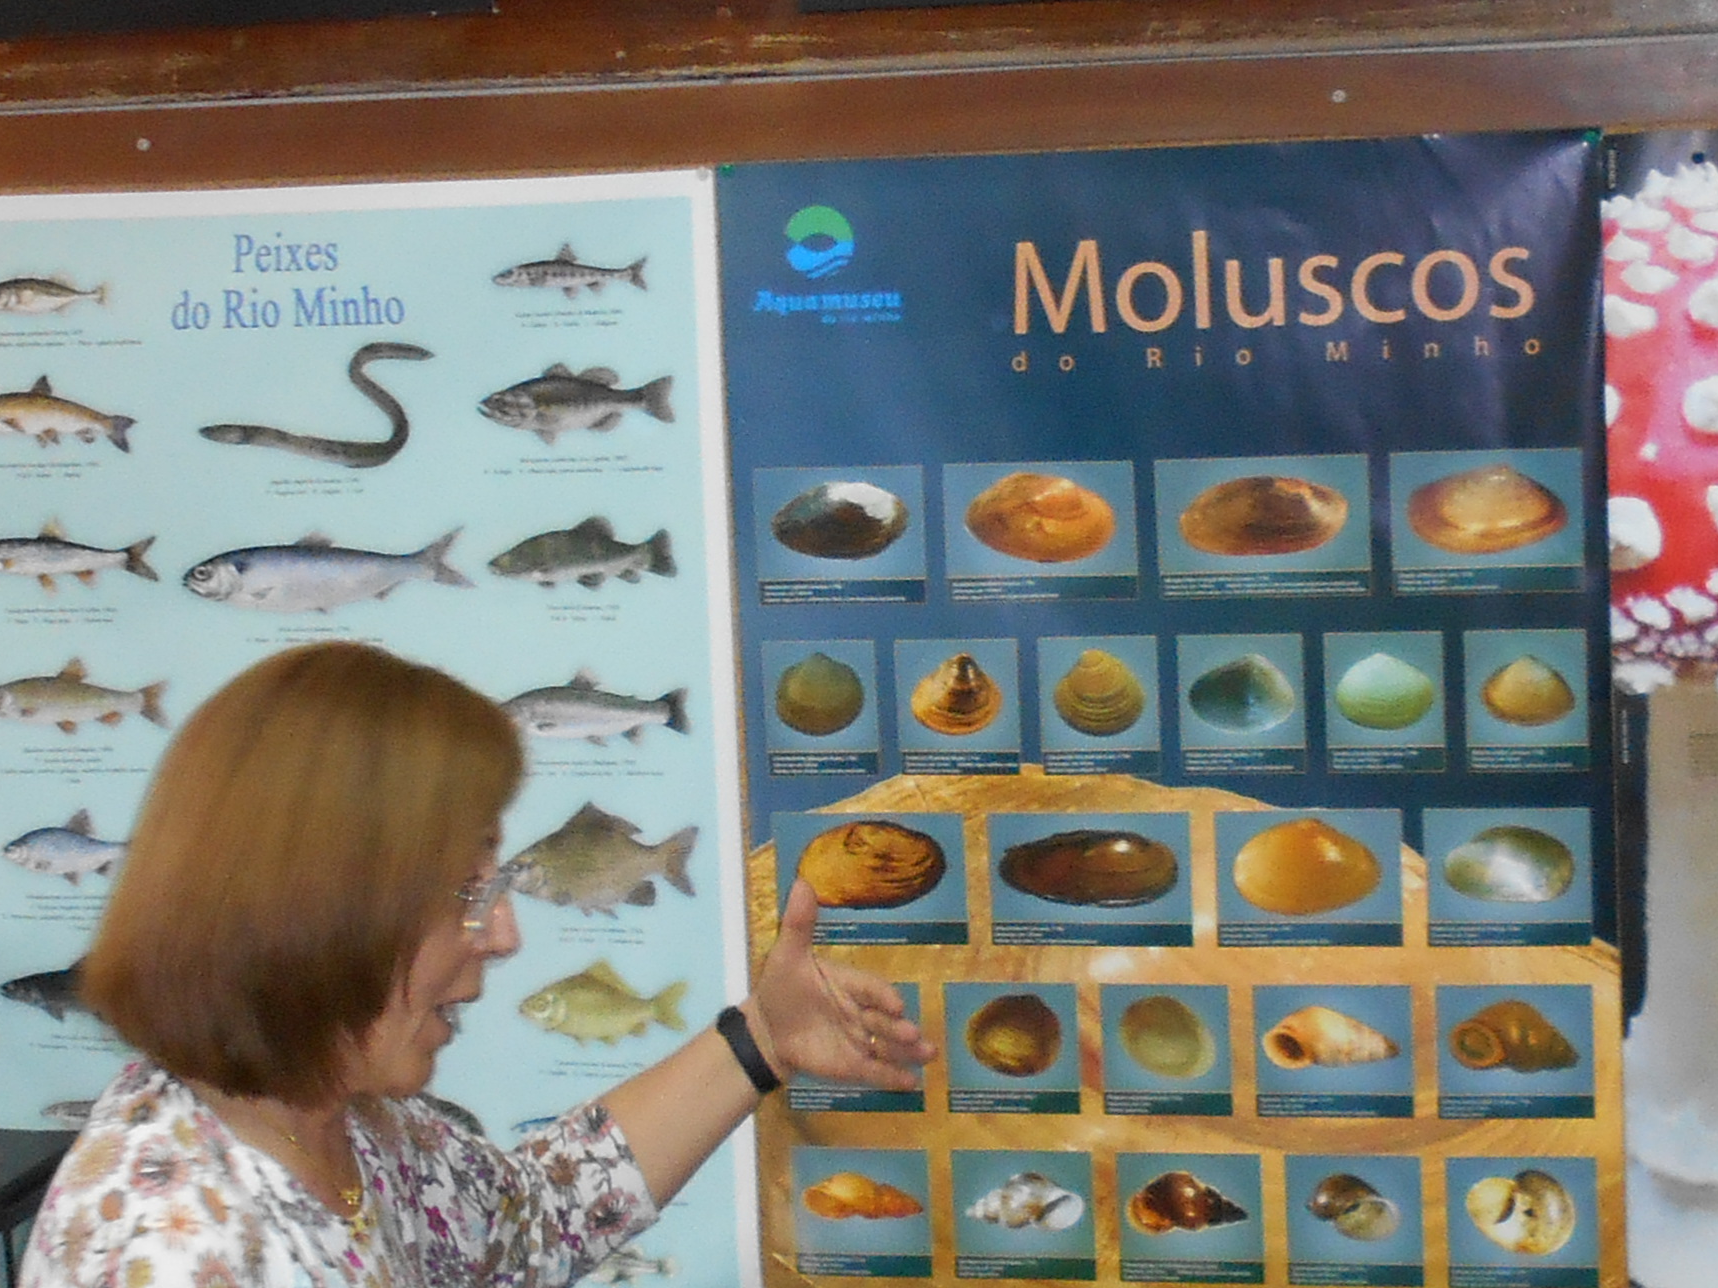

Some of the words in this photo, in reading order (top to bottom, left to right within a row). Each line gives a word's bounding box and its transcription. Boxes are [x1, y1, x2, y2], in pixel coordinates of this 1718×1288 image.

[232, 232, 339, 273] Peixes
[1014, 230, 1535, 334] Moluscos
[171, 290, 211, 330] do
[223, 287, 280, 329] Rio
[293, 285, 406, 327] Minho
[1012, 351, 1075, 372] do
[1147, 346, 1253, 368] Rio
[1325, 336, 1541, 363] Minho
